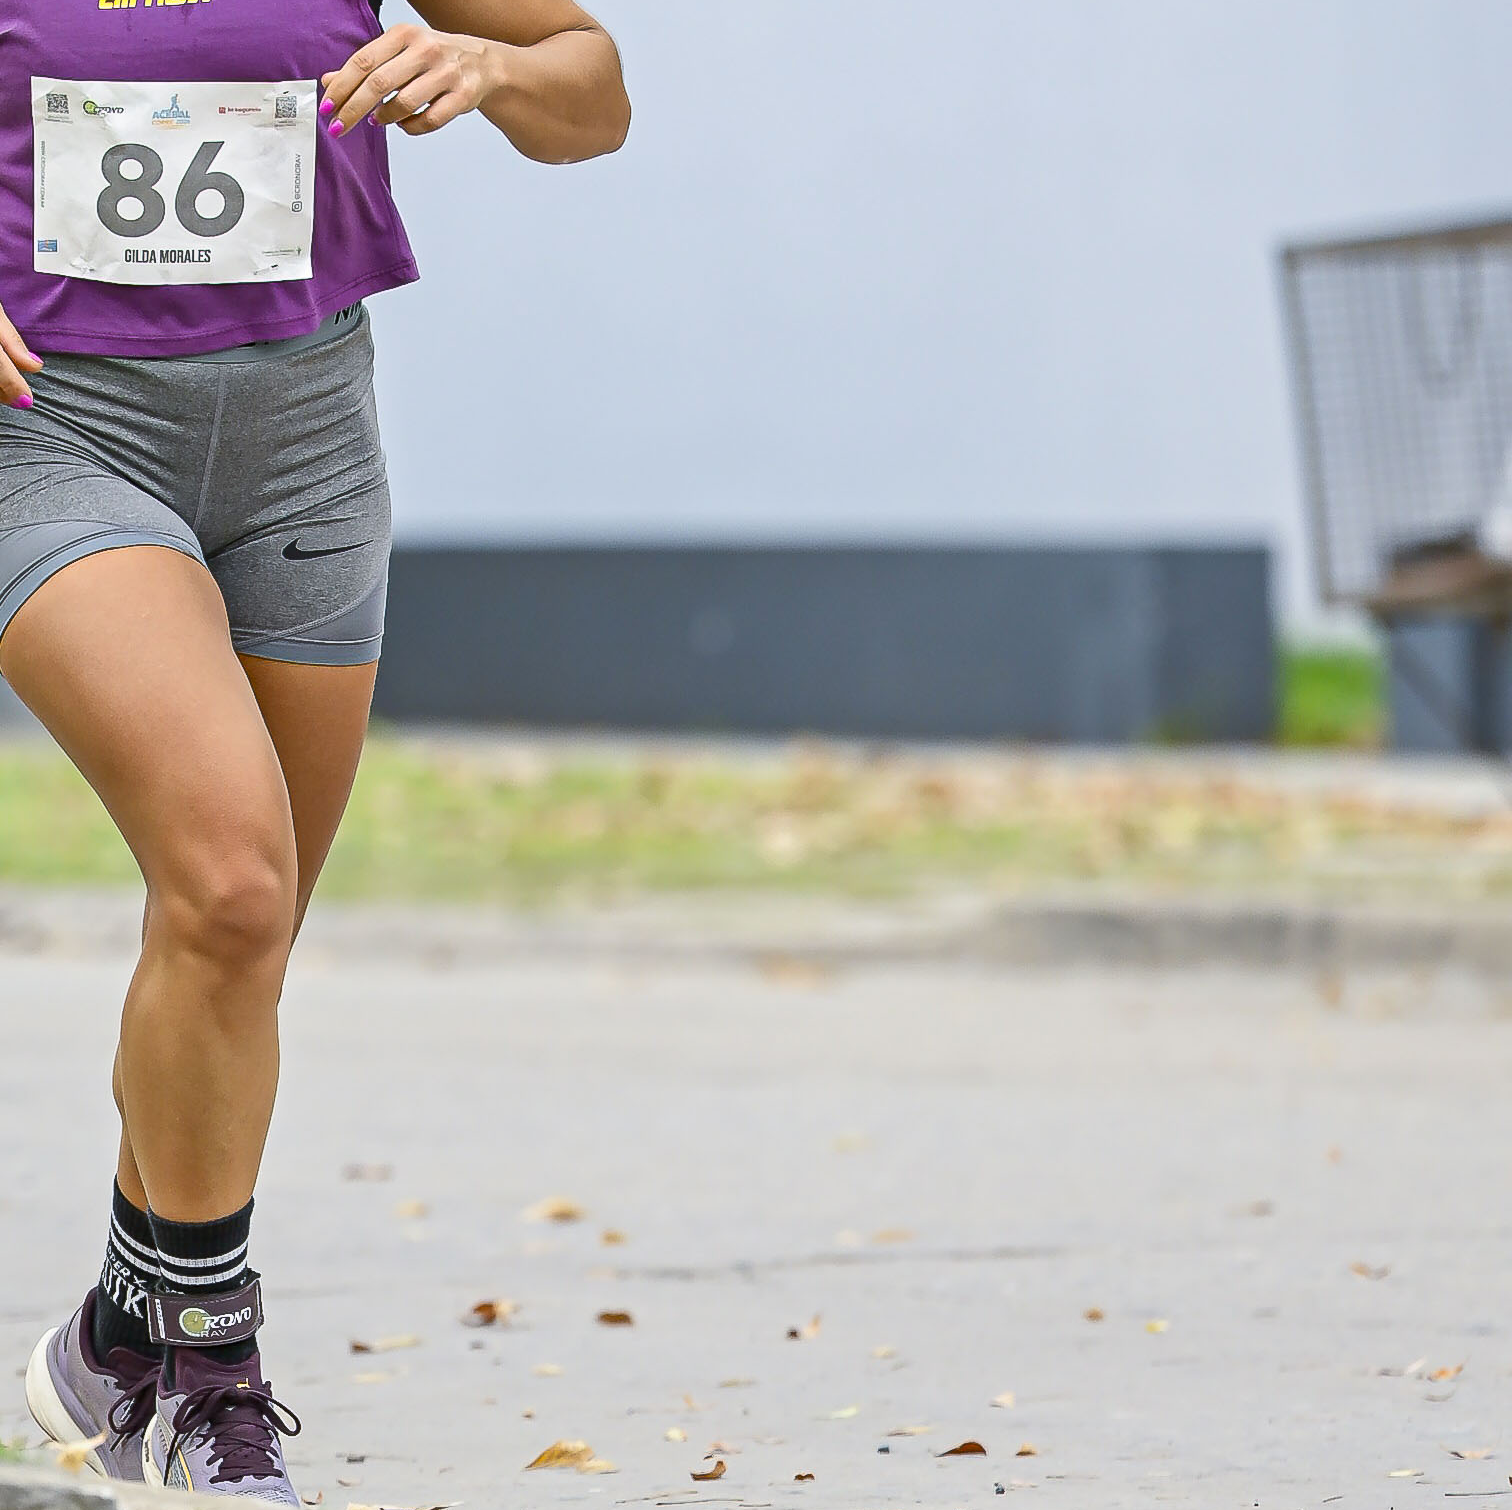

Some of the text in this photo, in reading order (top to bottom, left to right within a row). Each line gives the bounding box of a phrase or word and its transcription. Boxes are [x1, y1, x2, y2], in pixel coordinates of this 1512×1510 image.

[96, 141, 245, 238] 86
[124, 248, 211, 264] GILDA MORALES
[201, 1328, 227, 1338] RAV
